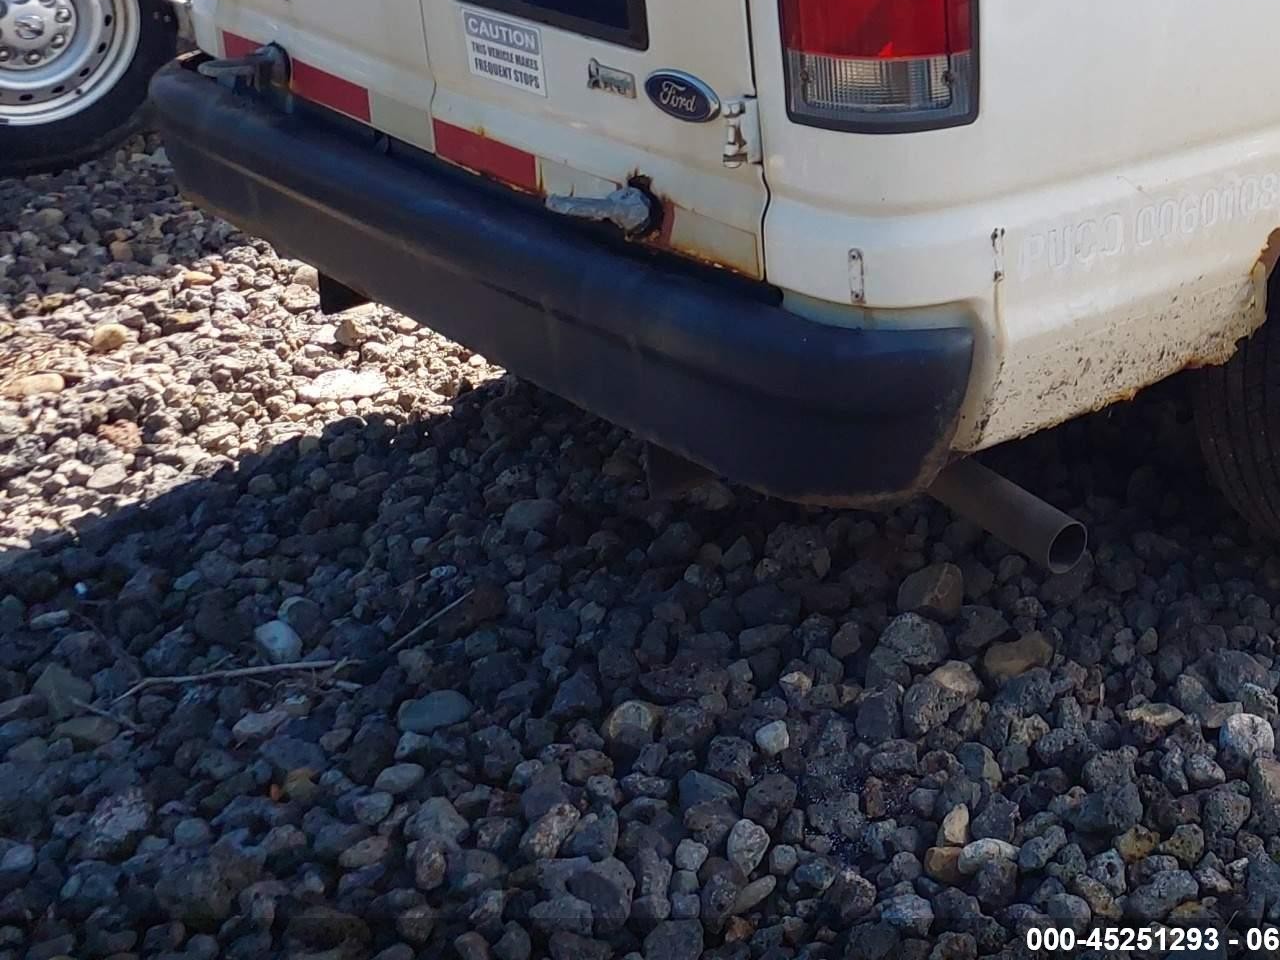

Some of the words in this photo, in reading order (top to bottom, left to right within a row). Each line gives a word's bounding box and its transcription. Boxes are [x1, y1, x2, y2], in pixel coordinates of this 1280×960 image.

[467, 17, 536, 50] CAUTION
[471, 41, 488, 56] THIS
[487, 46, 515, 64] VEHICLE
[514, 54, 540, 72] MAKES
[474, 57, 513, 81] FREQUENT
[513, 69, 541, 90] STOPS
[659, 80, 697, 114] Ford
